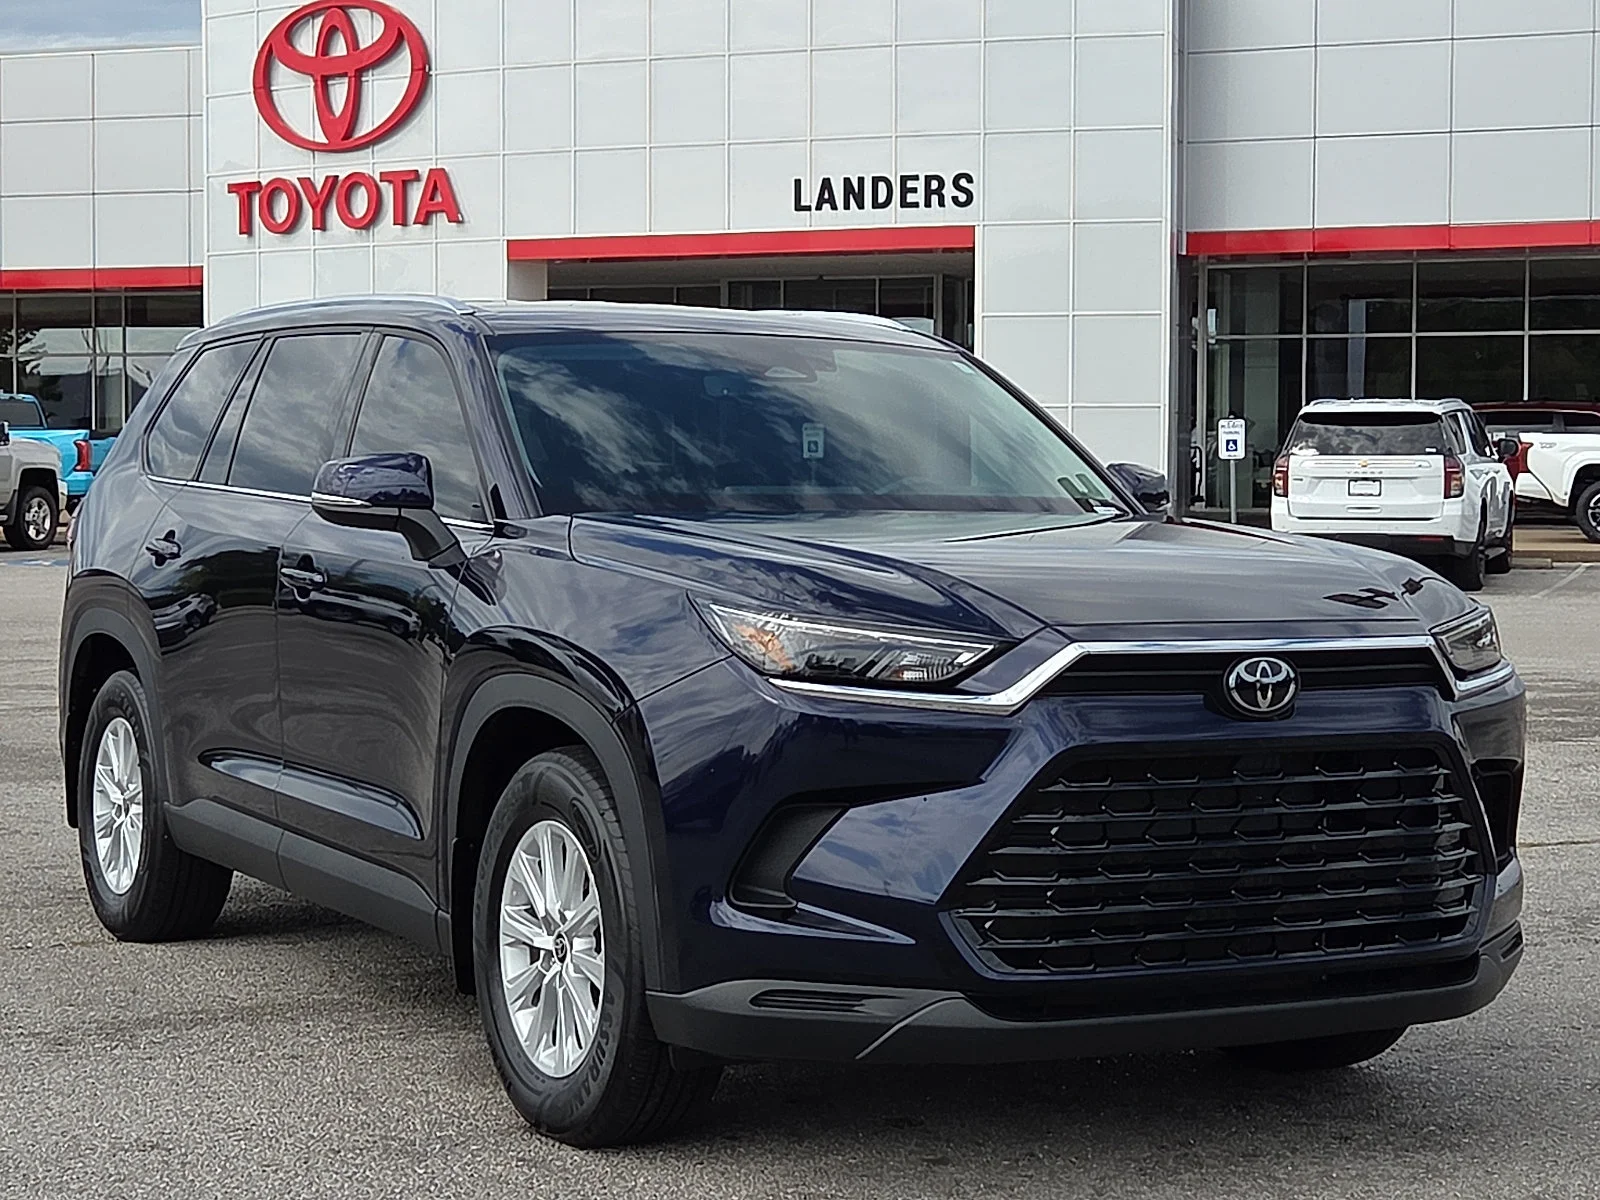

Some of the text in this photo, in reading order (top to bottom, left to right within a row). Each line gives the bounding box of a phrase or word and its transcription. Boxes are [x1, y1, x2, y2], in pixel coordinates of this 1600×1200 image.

[227, 167, 463, 237] TOYOTA
[794, 172, 975, 211] LANDERS
[564, 988, 617, 1119] ASSURAN
